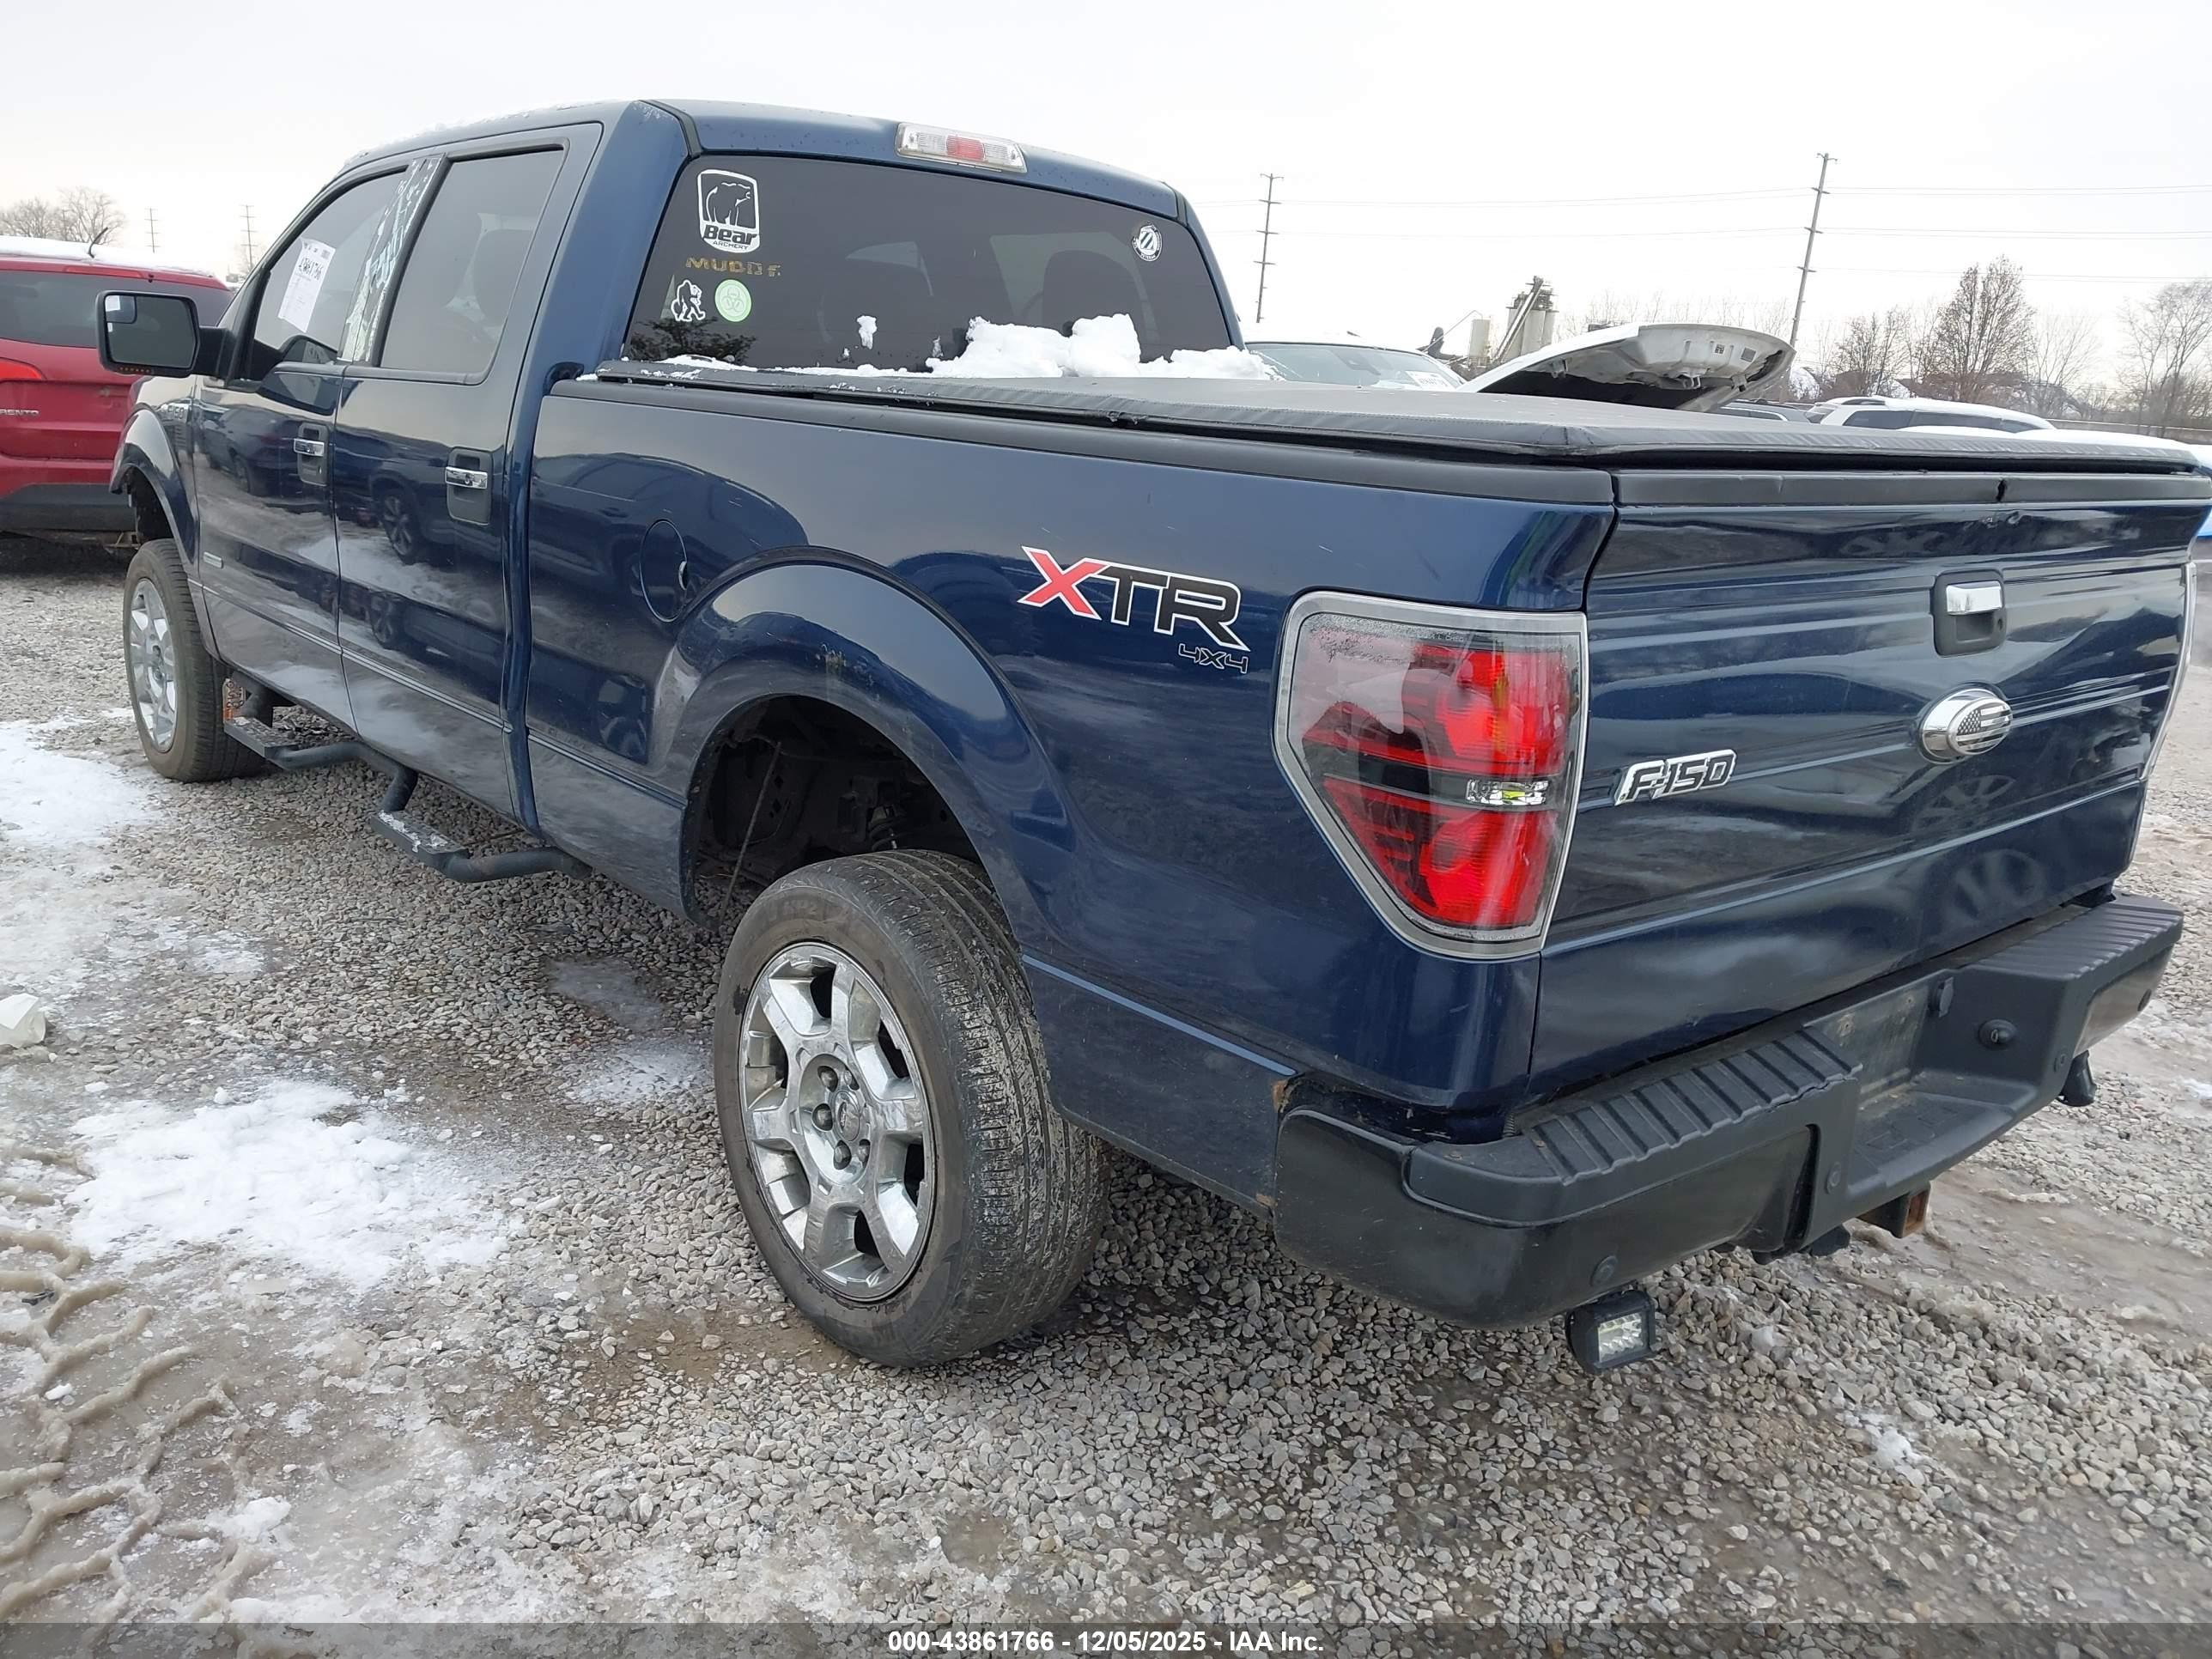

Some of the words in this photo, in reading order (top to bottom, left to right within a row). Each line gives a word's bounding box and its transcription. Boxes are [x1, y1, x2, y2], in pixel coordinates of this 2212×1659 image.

[703, 224, 758, 246] Bear
[713, 240, 749, 251] ARCHERY
[1017, 545, 1251, 653] XTR
[1614, 749, 1737, 805] F-150
